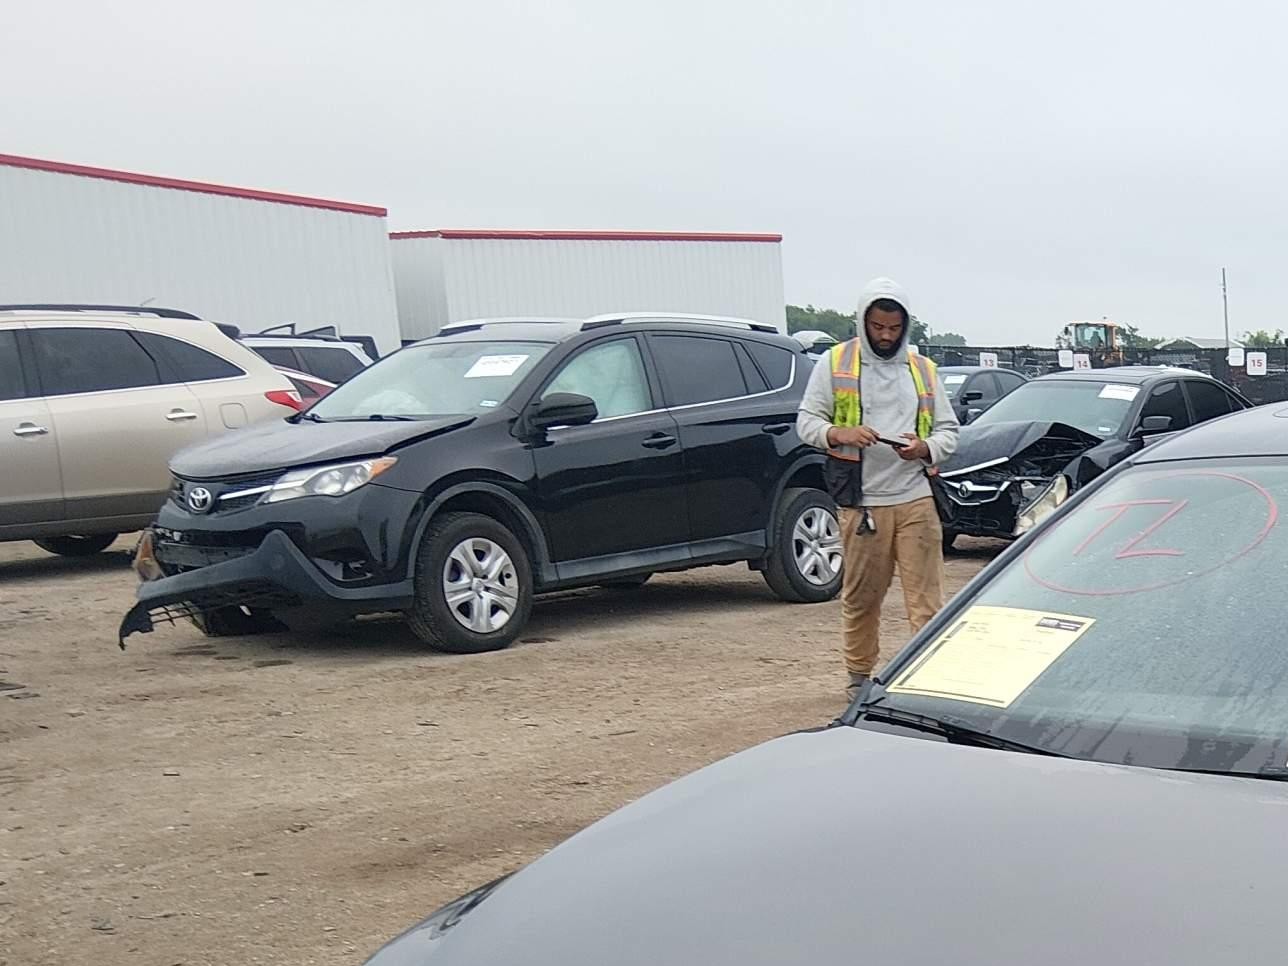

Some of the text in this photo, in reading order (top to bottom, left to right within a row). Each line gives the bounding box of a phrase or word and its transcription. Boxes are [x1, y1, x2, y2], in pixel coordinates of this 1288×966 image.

[984, 359, 994, 367] 13
[1078, 360, 1088, 368] 14
[1251, 359, 1263, 367] 15
